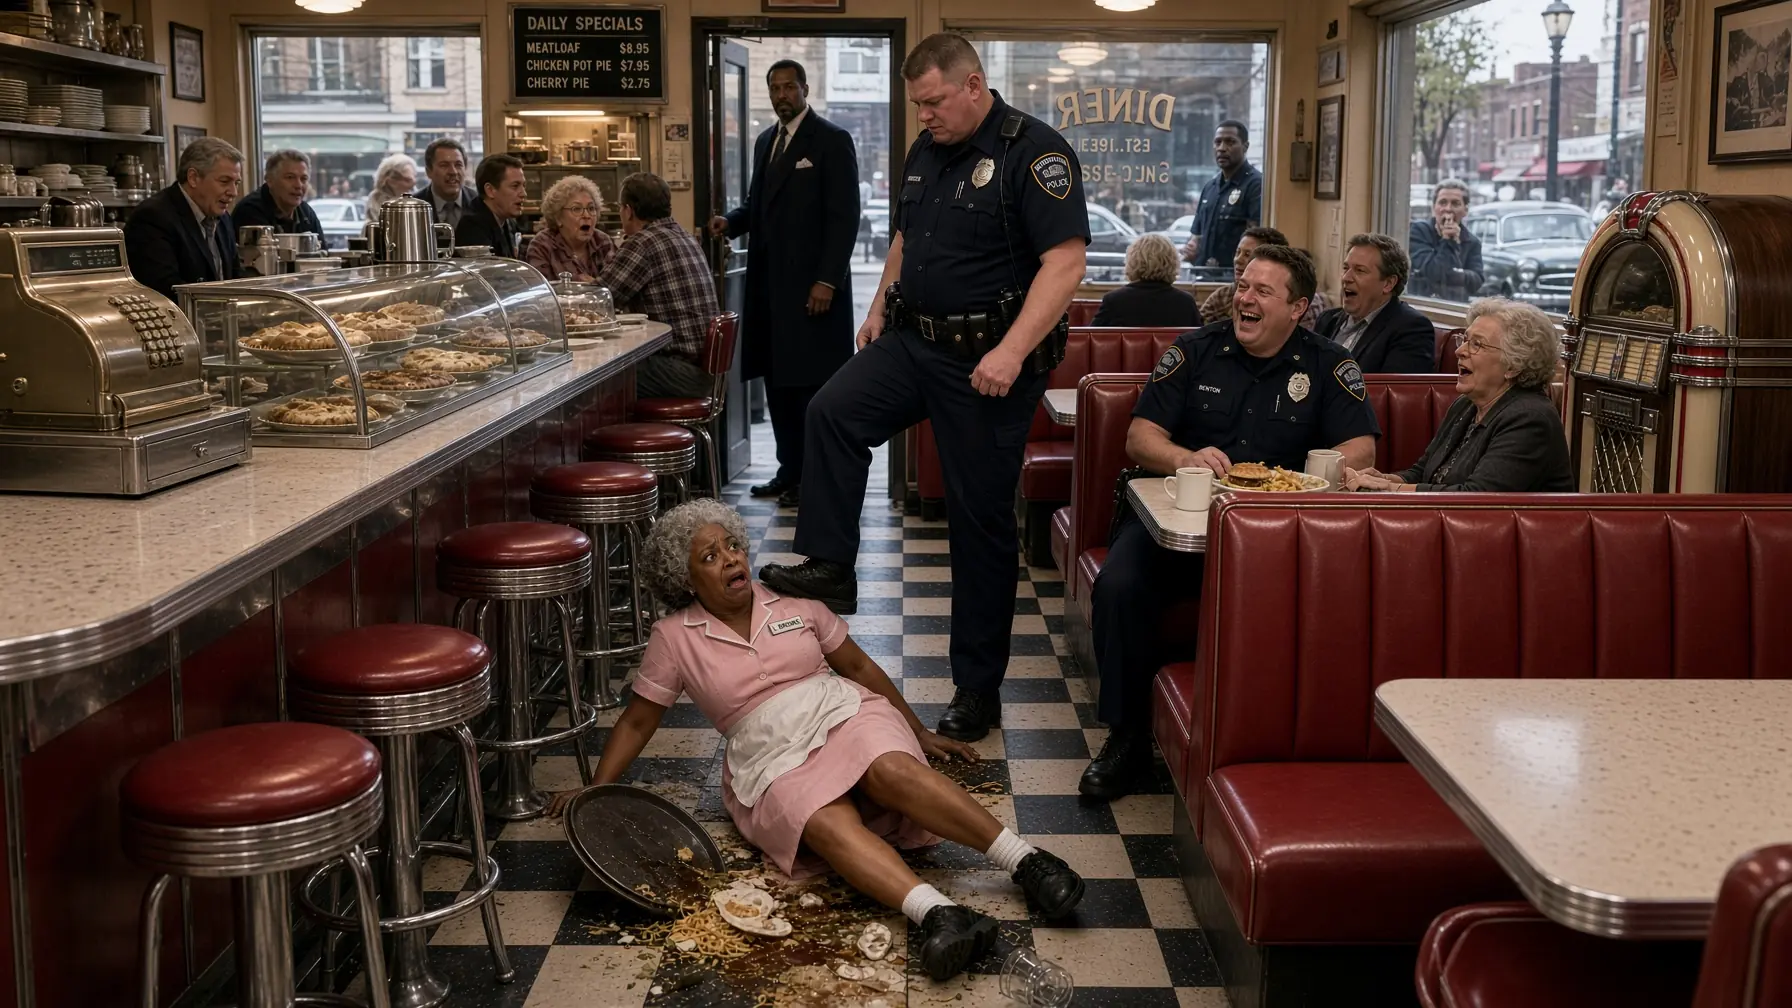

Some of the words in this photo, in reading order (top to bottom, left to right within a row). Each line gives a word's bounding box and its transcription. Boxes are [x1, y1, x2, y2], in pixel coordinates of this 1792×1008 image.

[527, 16, 568, 31] DAILY
[575, 16, 643, 31] SPECIALS
[526, 42, 581, 54] MEATLOAF
[619, 42, 650, 55] $8.95
[526, 59, 570, 71] CHICKEN
[573, 59, 593, 71] POT
[595, 59, 612, 72] PIE
[620, 59, 650, 72] $7.95
[527, 77, 569, 89] CHERRY
[572, 77, 590, 89] PIE
[620, 77, 650, 90] $2.75
[1046, 177, 1070, 190] POLICE
